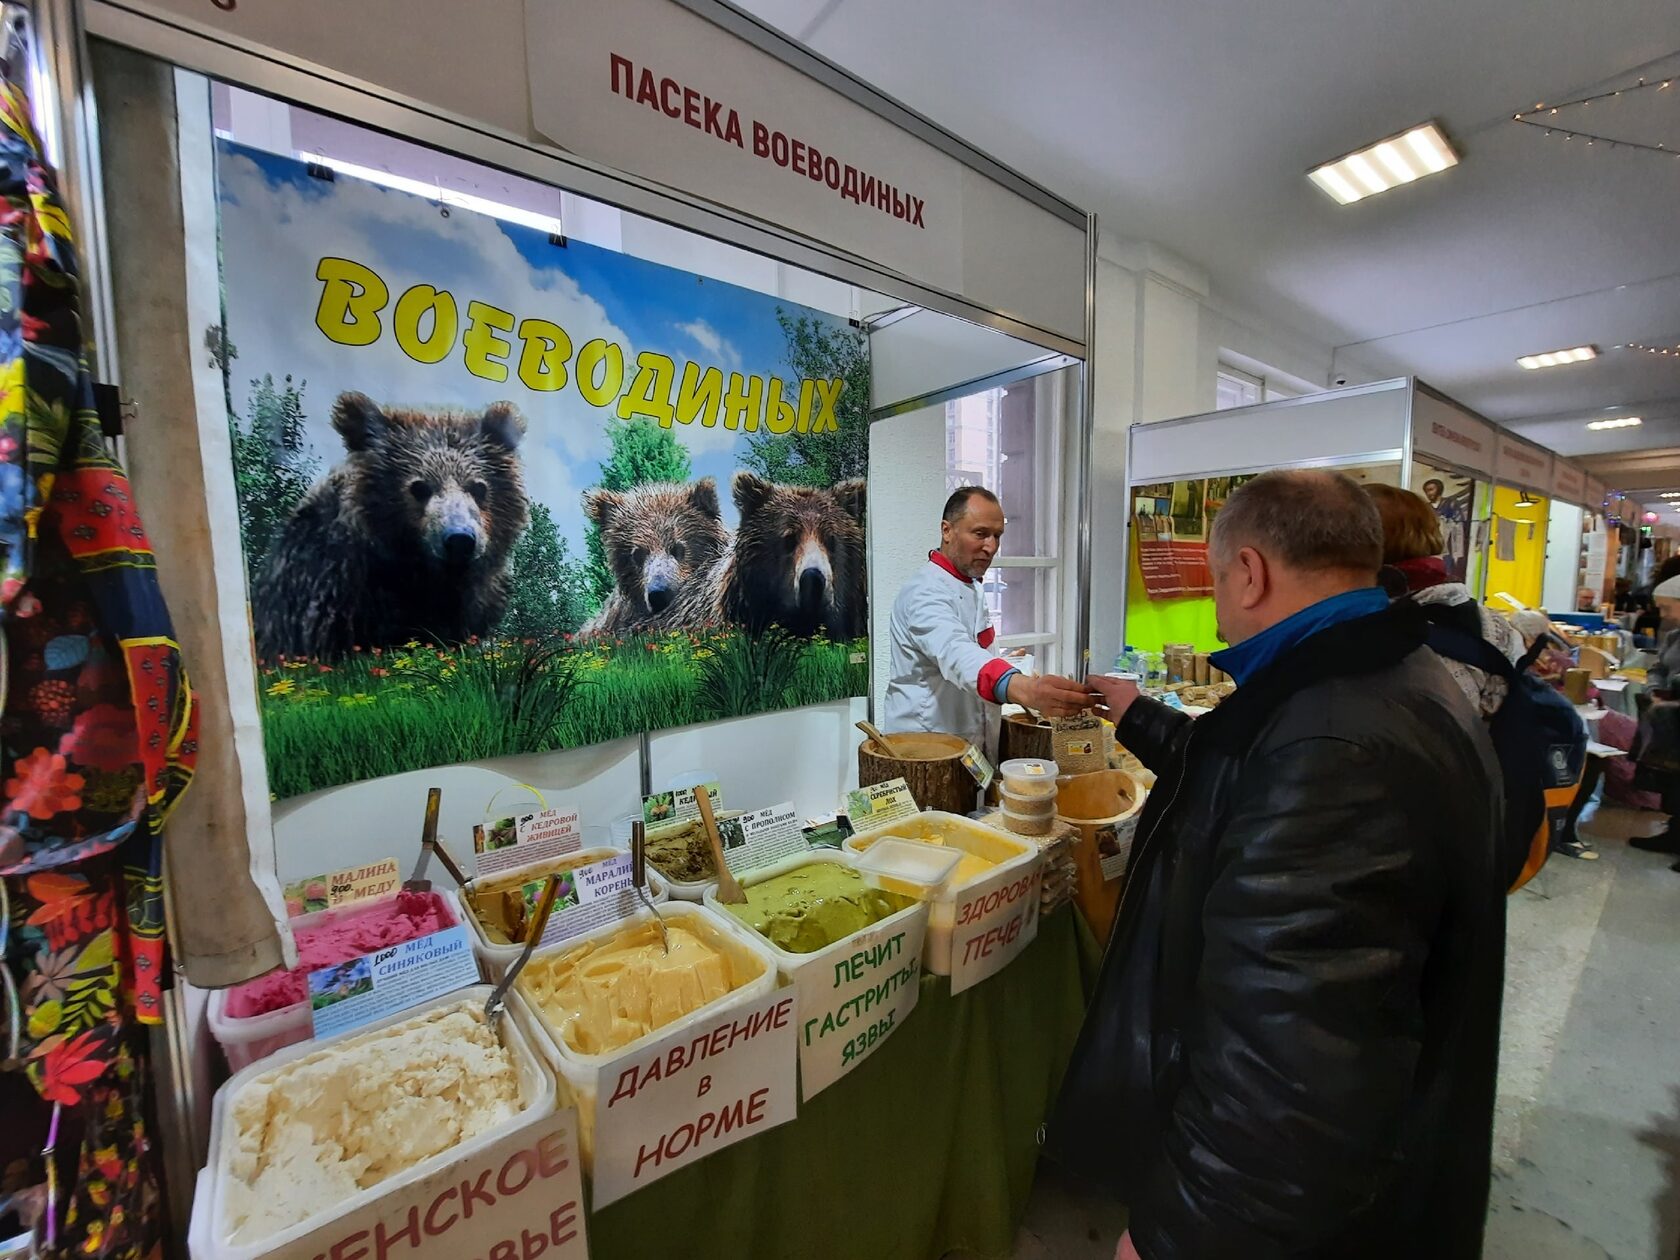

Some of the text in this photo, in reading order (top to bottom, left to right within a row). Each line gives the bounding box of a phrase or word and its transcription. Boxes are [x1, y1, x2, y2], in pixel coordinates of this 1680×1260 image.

[610, 52, 925, 229] ПАСЕКА ВОЕВОДИНЫХ
[314, 256, 845, 435] ВОЕВОДИНЫХ
[527, 825, 572, 842] ЖИВИЦЕЙ
[531, 813, 578, 831] КЕДРОВОЙ
[751, 811, 796, 830] ПРОПОЛИСОМ
[331, 861, 397, 886] МАЛИНА
[353, 879, 396, 900] МЕДУ
[594, 877, 634, 898] КОРЕНЬ
[378, 939, 464, 977] СИНЯКОВЫЙ
[833, 932, 906, 989] ЛЕЧИТ
[608, 998, 794, 1109] ДАВЛЕНИЕ
[842, 1008, 896, 1067] ЯЗВЫ
[633, 1087, 770, 1178] НОРМЕ
[311, 1128, 570, 1260] ЕНСКОЕ
